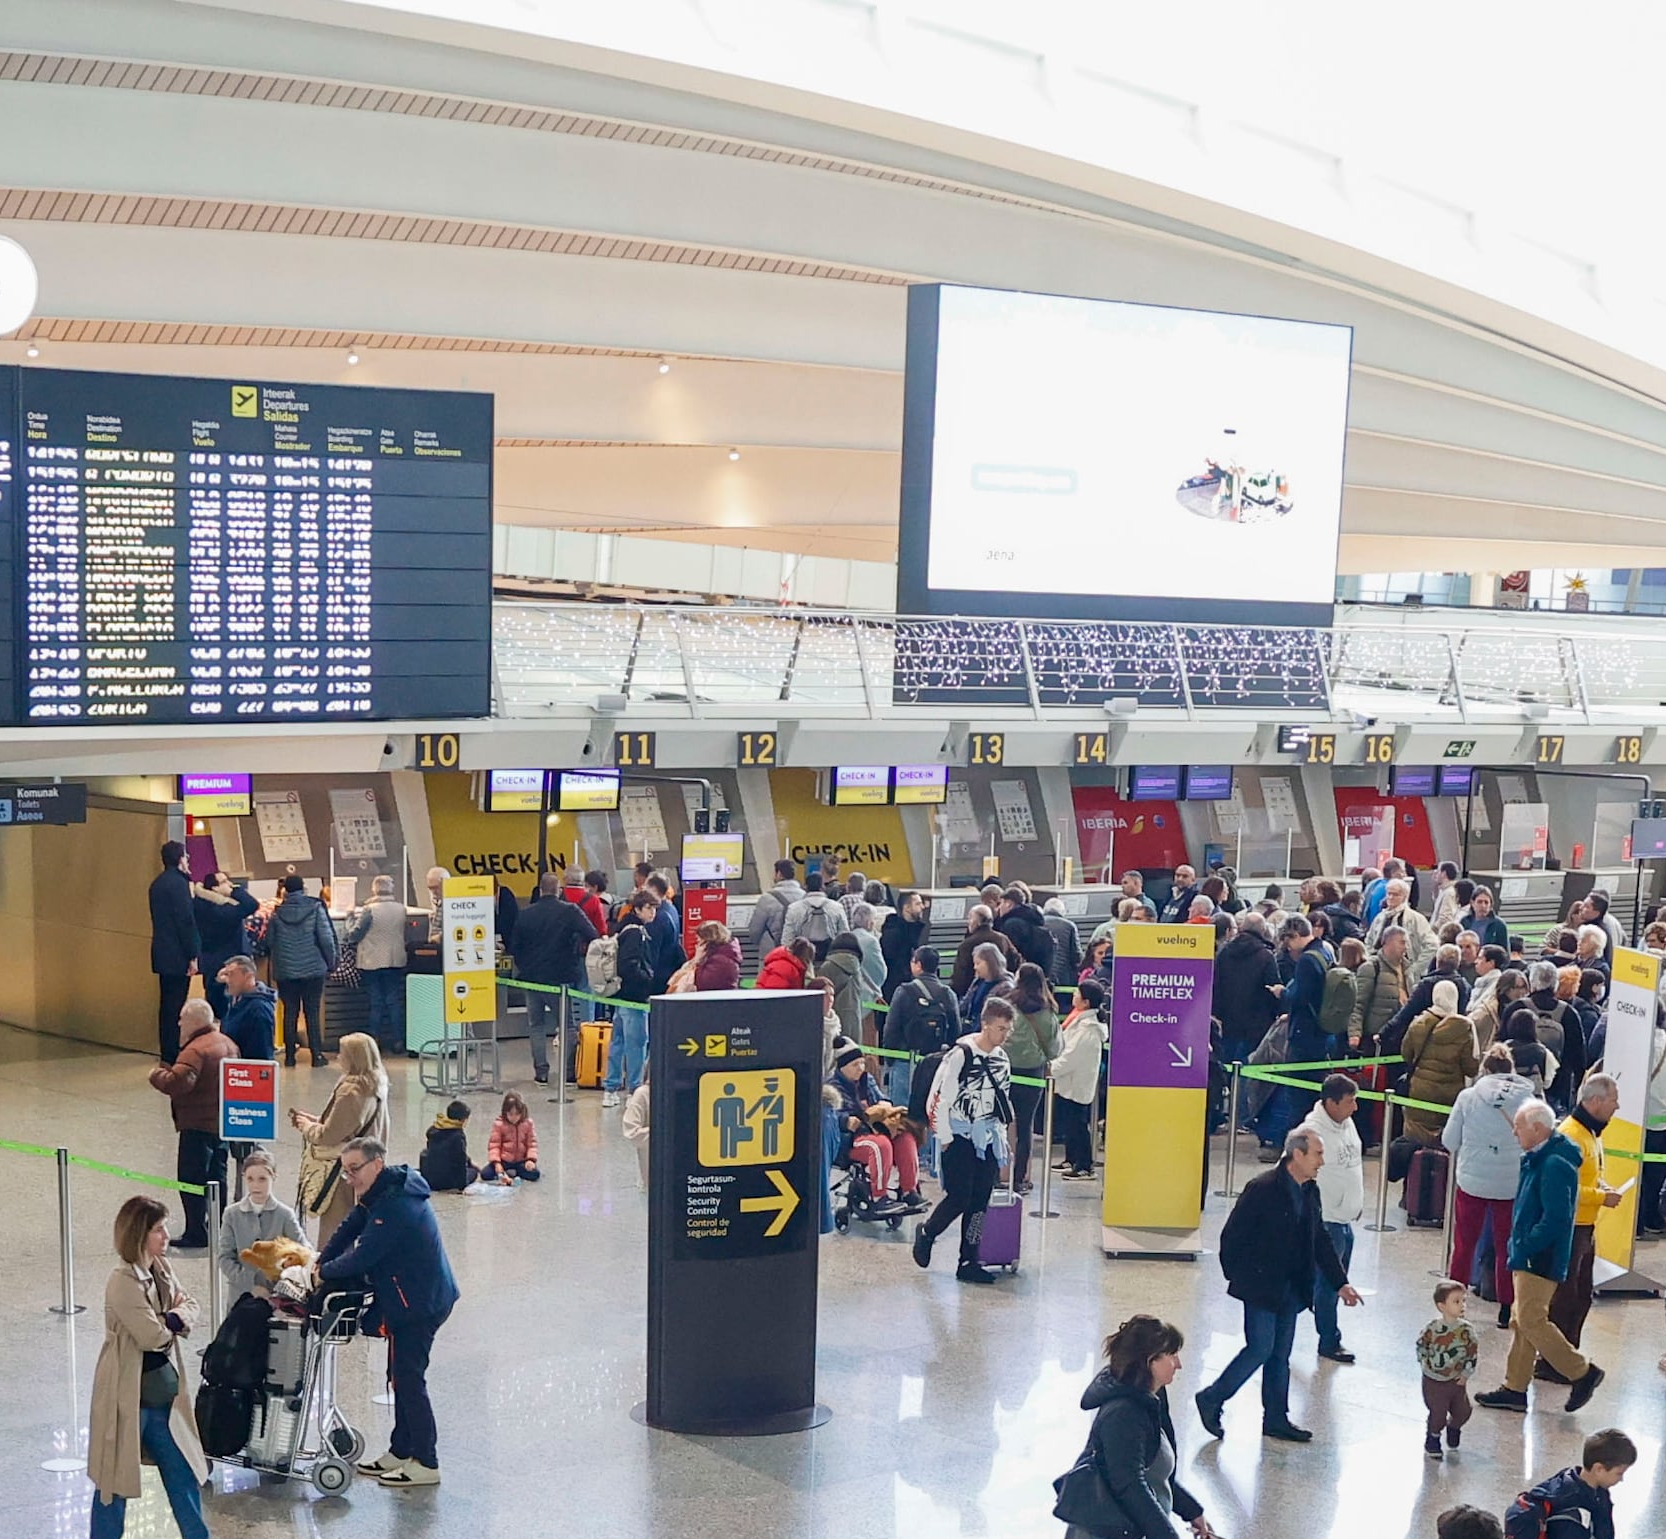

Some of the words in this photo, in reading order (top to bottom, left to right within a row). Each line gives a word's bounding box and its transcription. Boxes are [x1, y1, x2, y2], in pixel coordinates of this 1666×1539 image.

[263, 388, 295, 400] Irteerak
[263, 399, 309, 412] Departures
[264, 411, 299, 423] Salidas
[28, 430, 47, 440] Hora
[87, 433, 118, 442] Destino
[193, 437, 215, 447] Vuelo
[420, 735, 459, 767] 10
[619, 734, 651, 765] 11
[741, 734, 775, 764] 12
[971, 735, 1003, 764] 13
[1077, 735, 1106, 764] 14
[1307, 736, 1333, 763] 15
[1366, 736, 1393, 763] 16
[1538, 737, 1564, 762] 17
[1617, 737, 1641, 762] 18
[187, 778, 233, 789] PREMIUM
[16, 787, 59, 798] Komunak
[17, 800, 40, 809] Toilets
[17, 811, 44, 822] Aseos
[1082, 817, 1128, 829] IBERIA
[451, 902, 477, 910] CHECK
[1157, 934, 1197, 948] vueling
[1132, 973, 1195, 987] PREMIUM
[1131, 987, 1193, 1000] TIMEFLEX
[1616, 1000, 1646, 1018] CHECK-IN
[1130, 1012, 1178, 1024] Check-in
[228, 1068, 249, 1078] First
[228, 1077, 253, 1087] Class
[228, 1107, 268, 1118] Business
[228, 1116, 253, 1126] Class
[687, 1175, 736, 1187] Segurtasun-
[687, 1184, 722, 1194] kontrola
[687, 1197, 721, 1208] Security
[687, 1206, 718, 1216] Control
[687, 1218, 718, 1229] Control
[719, 1217, 730, 1227] de
[687, 1228, 728, 1239] seguridad
